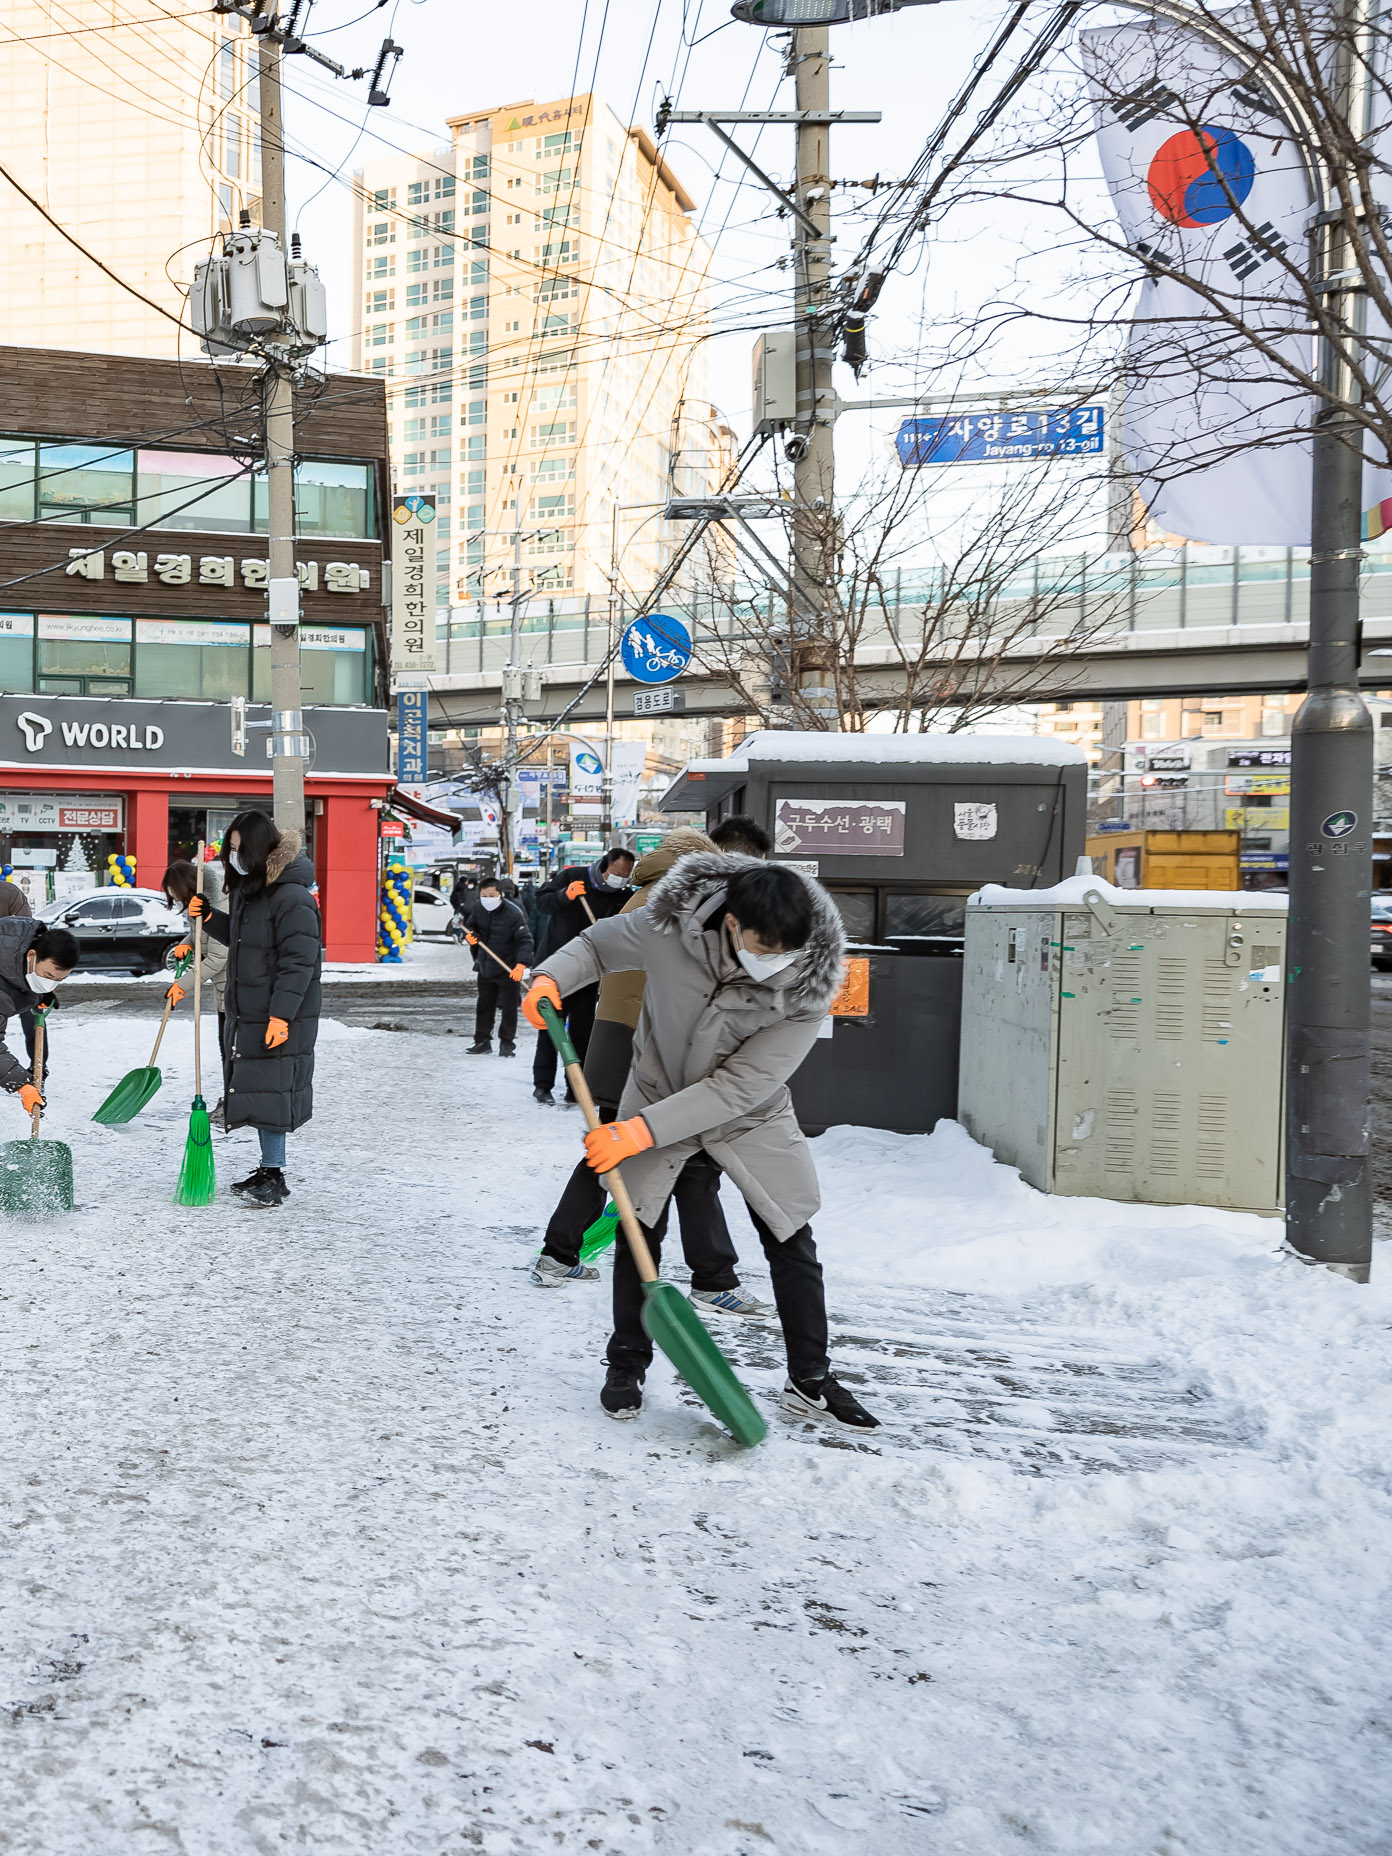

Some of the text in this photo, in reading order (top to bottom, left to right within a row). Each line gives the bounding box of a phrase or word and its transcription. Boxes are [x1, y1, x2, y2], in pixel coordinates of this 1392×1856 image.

[948, 409, 1099, 442] 자양로13길
[983, 437, 1099, 458] Jayang-ro 13-gil
[403, 528, 427, 654] 제일경희한의원
[61, 721, 165, 750] WORLD
[63, 811, 115, 825] 전문상담
